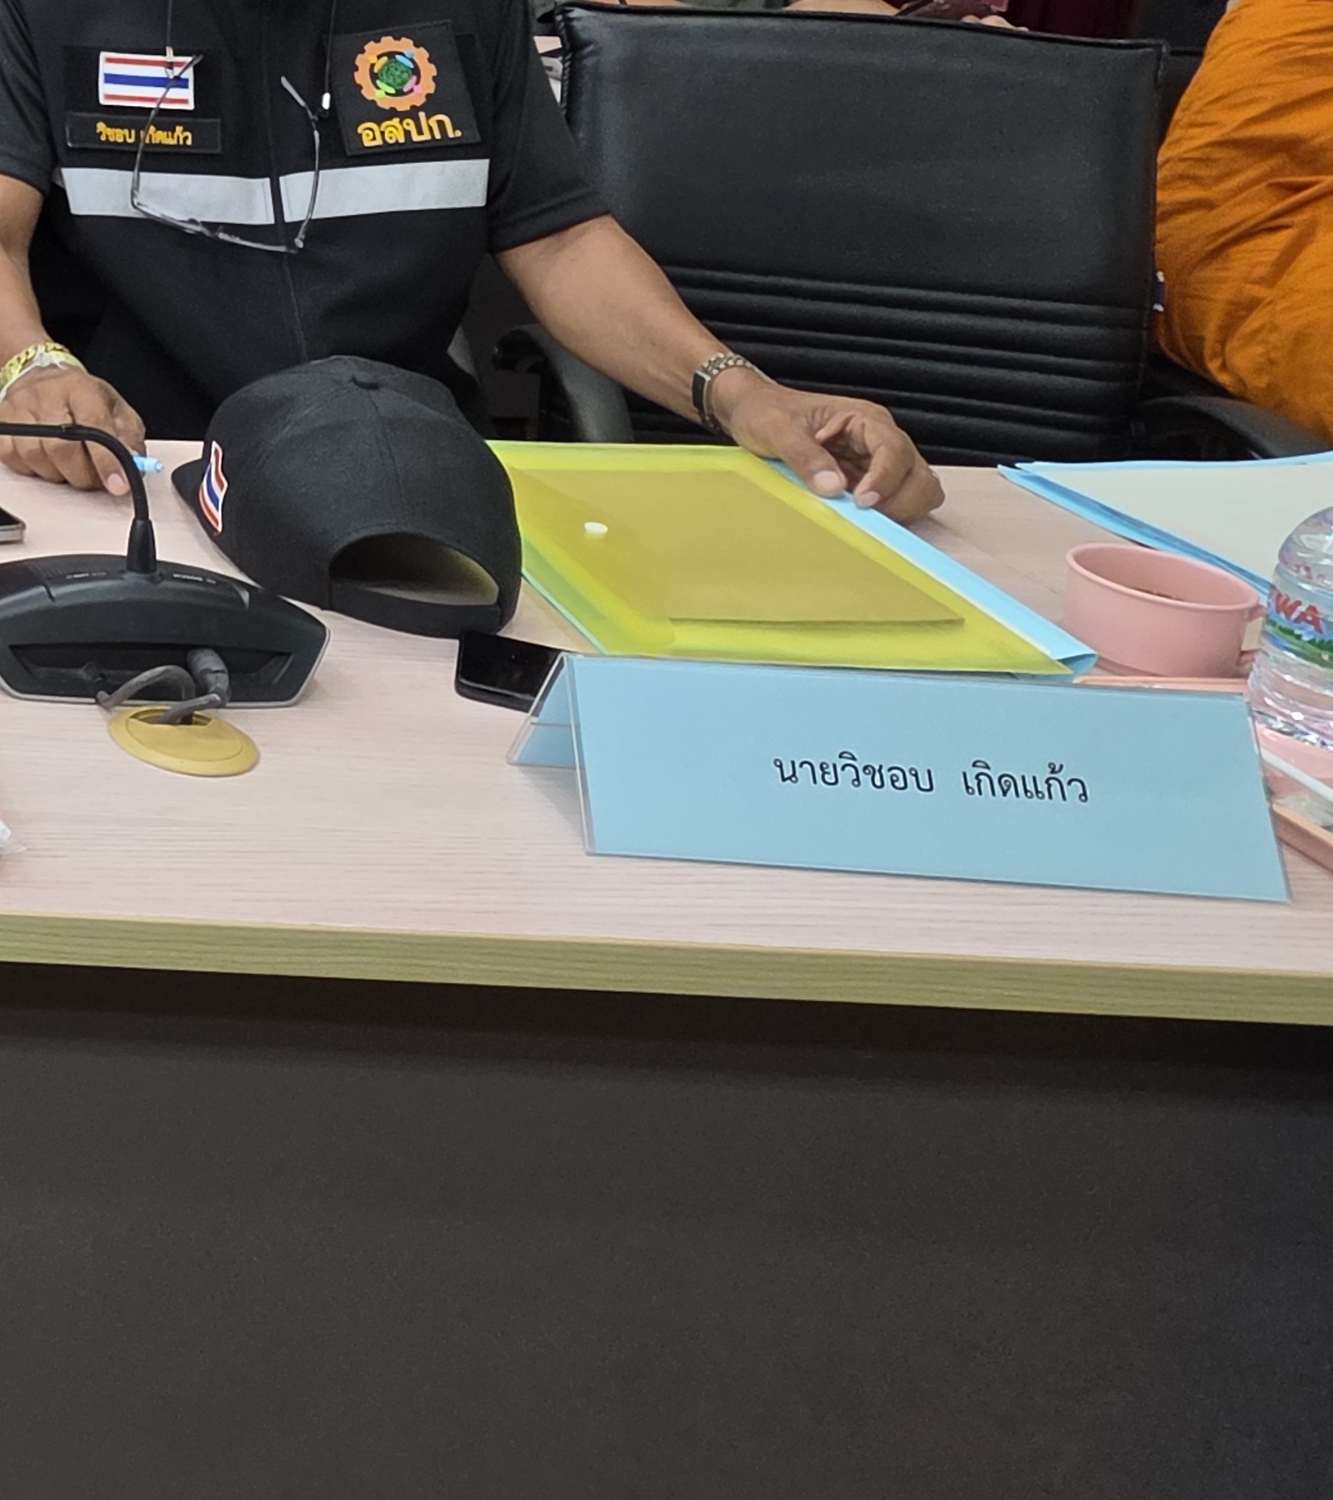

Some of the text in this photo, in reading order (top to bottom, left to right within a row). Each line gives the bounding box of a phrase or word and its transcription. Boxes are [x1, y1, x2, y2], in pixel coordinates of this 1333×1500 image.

[357, 111, 462, 147] อสปก.
[773, 750, 1089, 803] นายวิชอบ เกิดแก้ว
